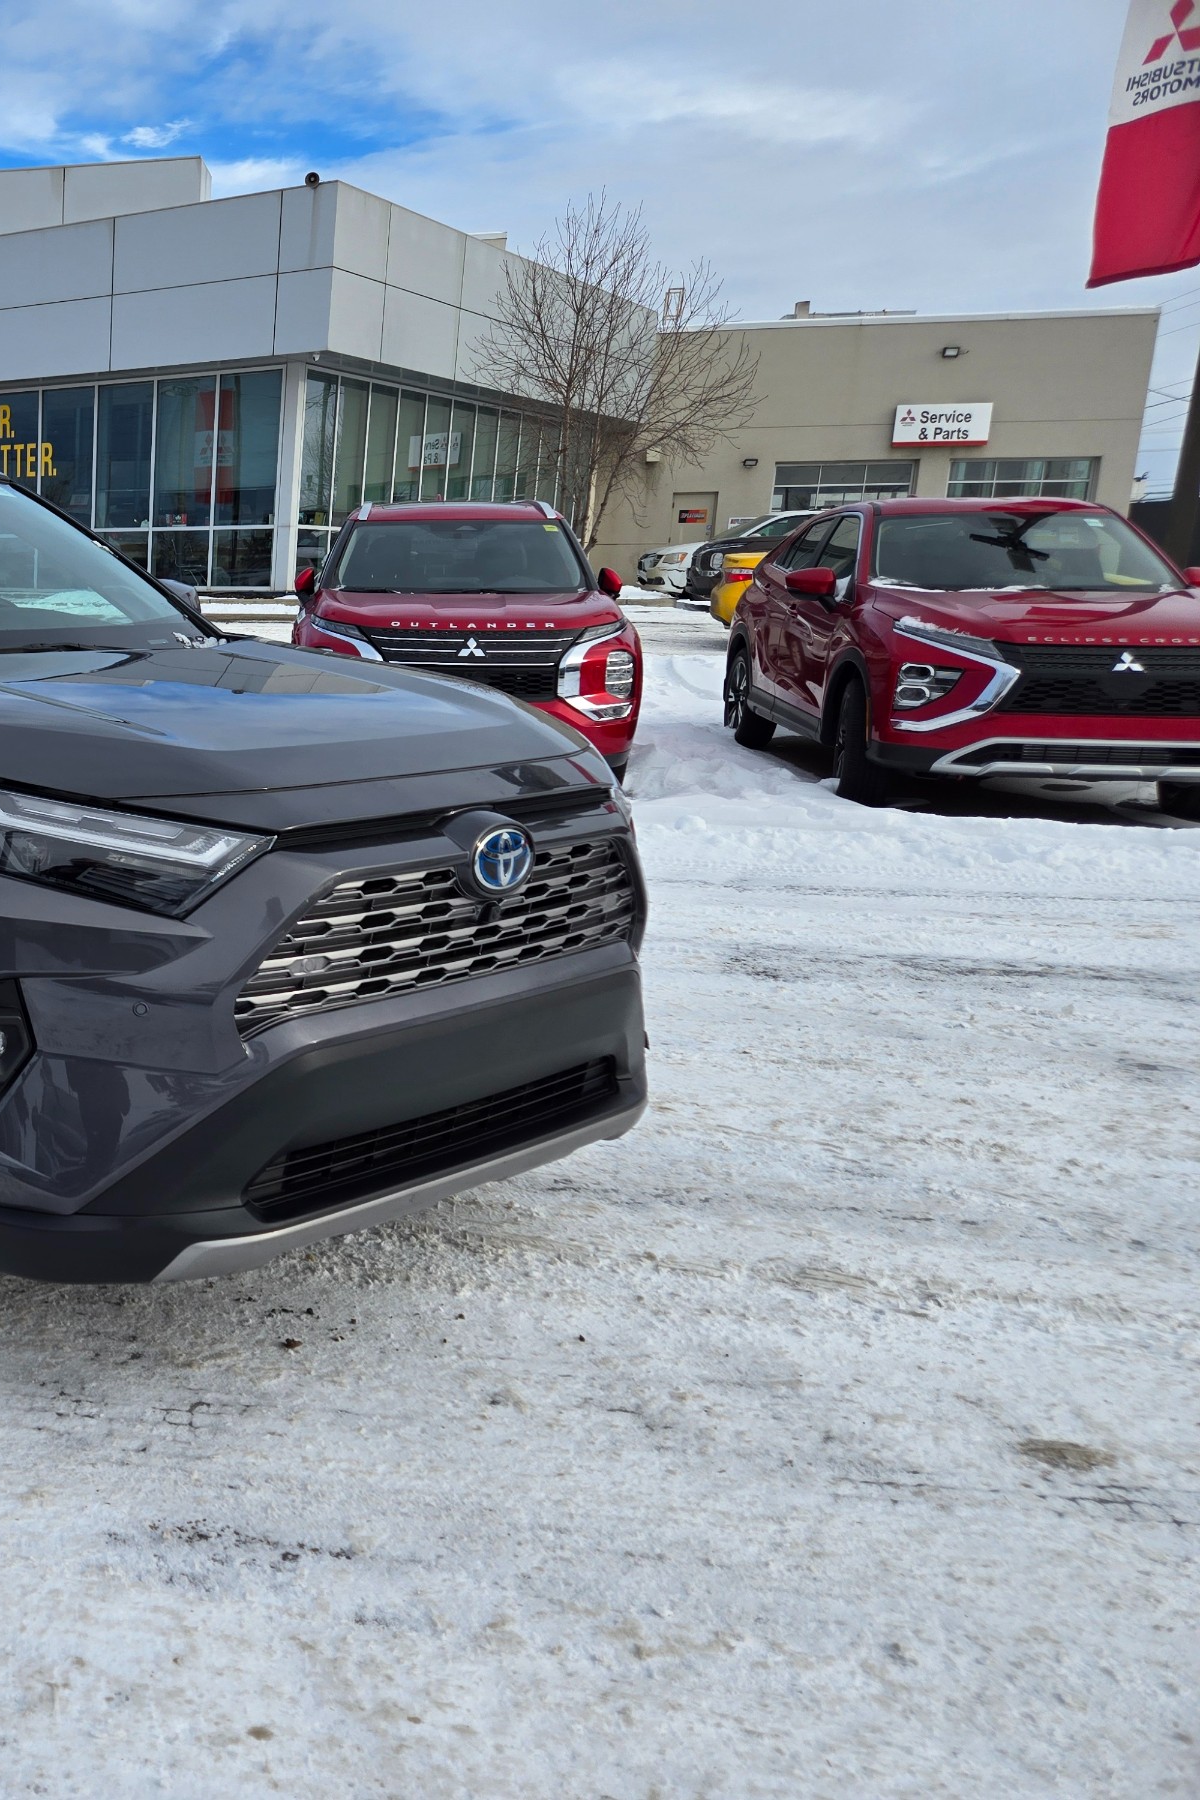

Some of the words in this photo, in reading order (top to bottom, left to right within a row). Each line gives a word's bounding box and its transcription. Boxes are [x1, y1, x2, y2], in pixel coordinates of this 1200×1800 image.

[920, 410, 972, 424] Service
[918, 427, 928, 440] &
[933, 427, 969, 440] Parts
